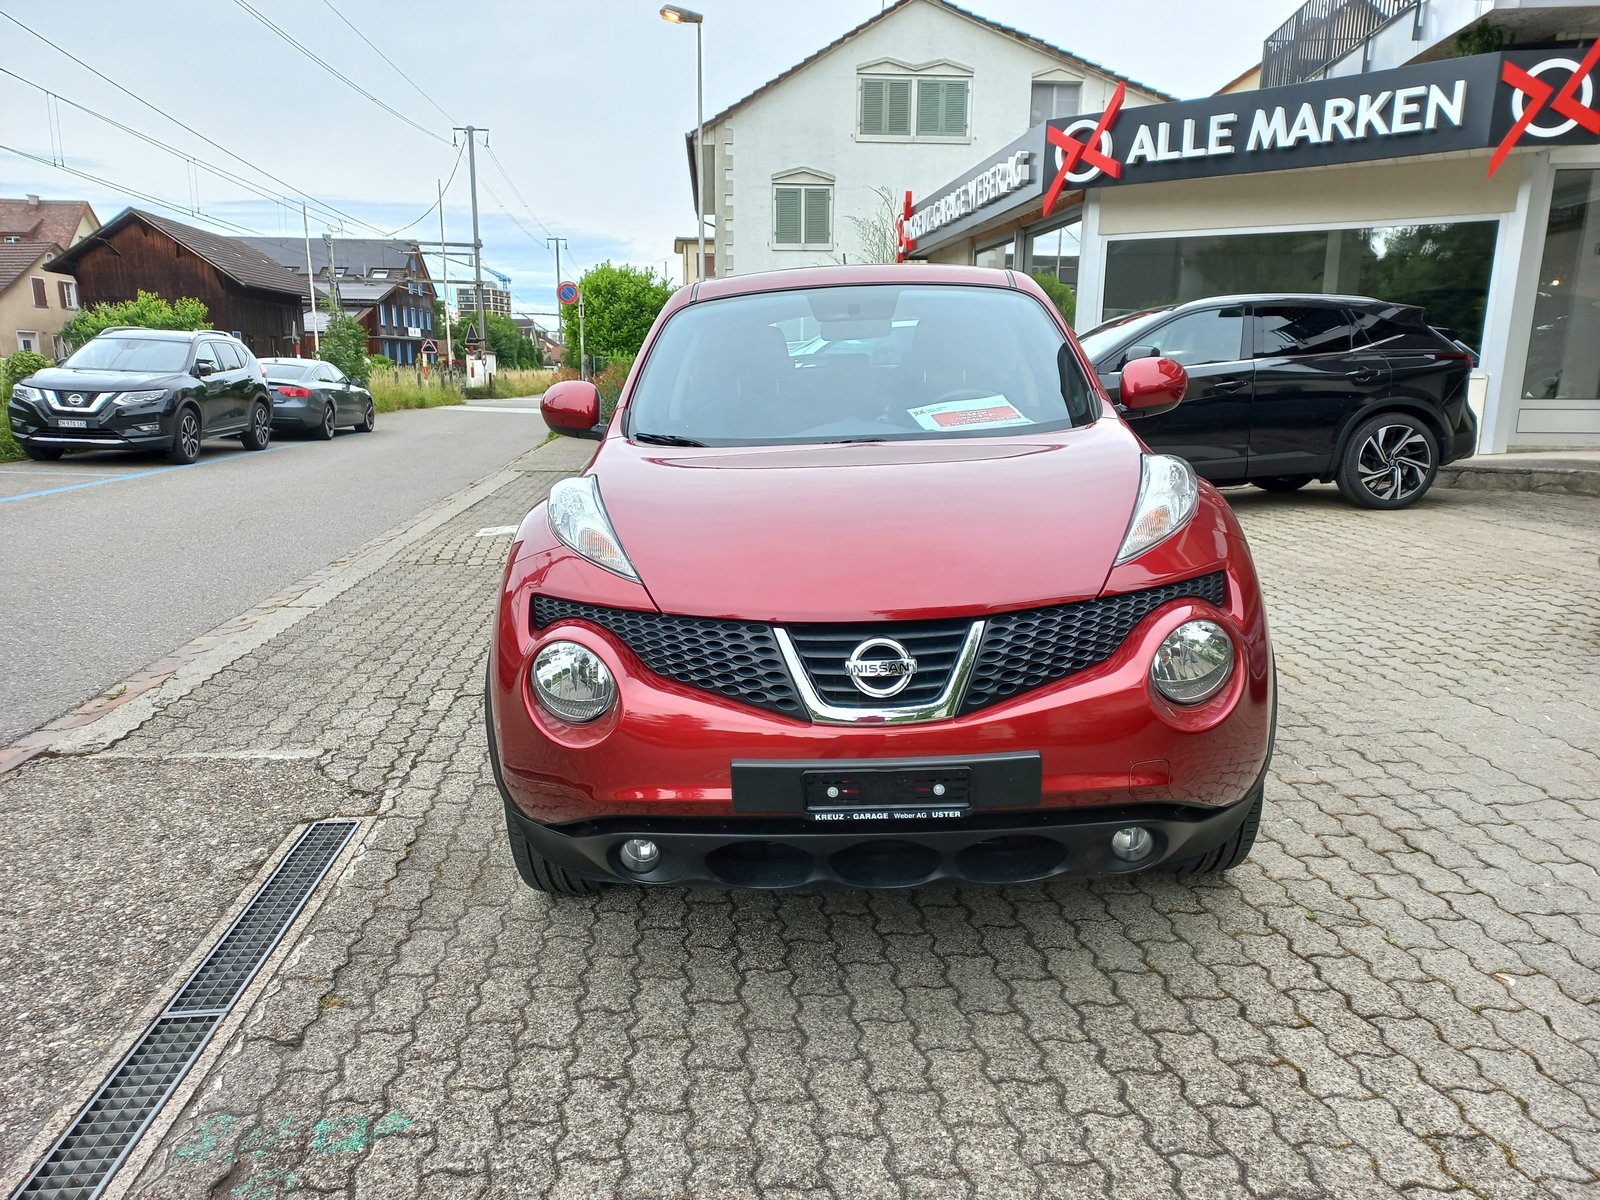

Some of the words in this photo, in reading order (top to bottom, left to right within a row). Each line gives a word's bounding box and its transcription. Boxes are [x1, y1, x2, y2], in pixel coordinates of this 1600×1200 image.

[1125, 112, 1238, 165] ALLE
[1245, 79, 1467, 151] MARKEN
[967, 163, 1010, 215] WEBER
[1006, 150, 1030, 189] AG
[853, 662, 910, 674] NISSAN
[814, 813, 845, 821] KREUZ
[852, 812, 889, 820] GARAGE
[916, 811, 927, 819] AG
[931, 810, 961, 818] USTER
